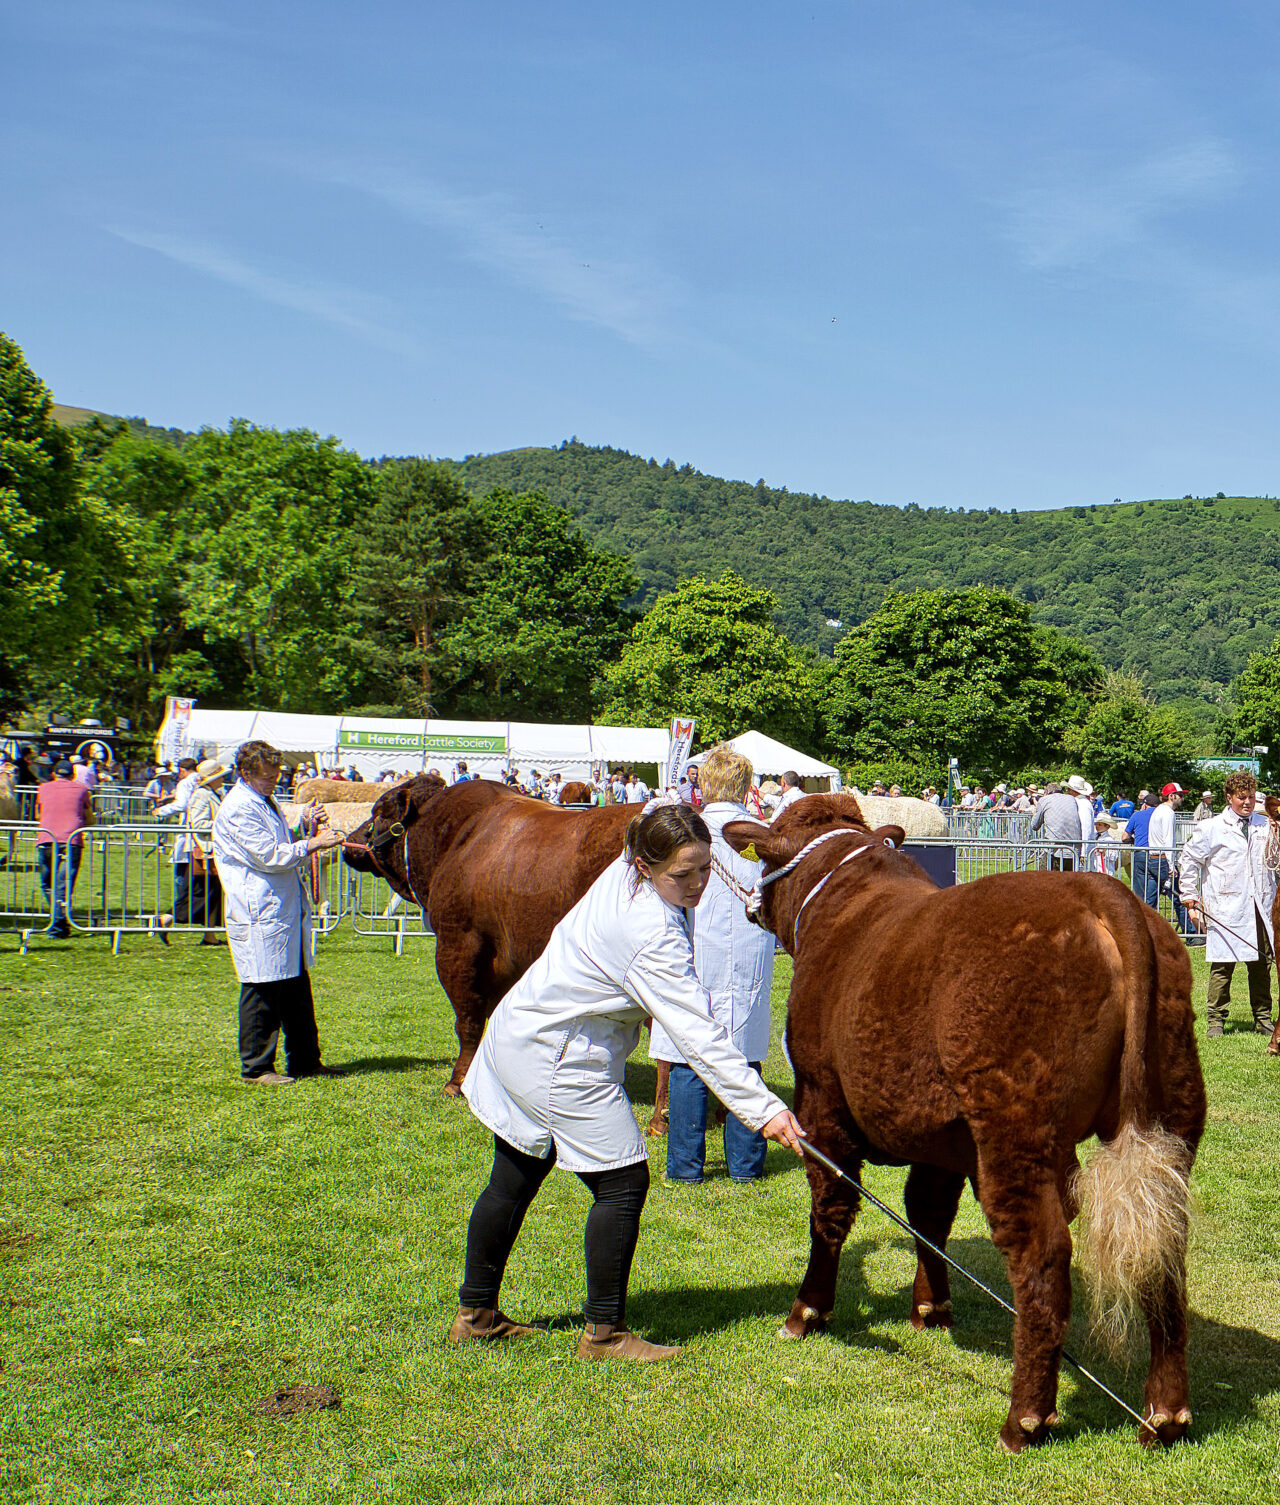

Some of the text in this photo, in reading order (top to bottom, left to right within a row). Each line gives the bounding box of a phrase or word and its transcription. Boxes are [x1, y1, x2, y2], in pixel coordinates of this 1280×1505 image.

[367, 733, 496, 750] Hereford Cattle Society
[671, 741, 685, 784] Herefords
